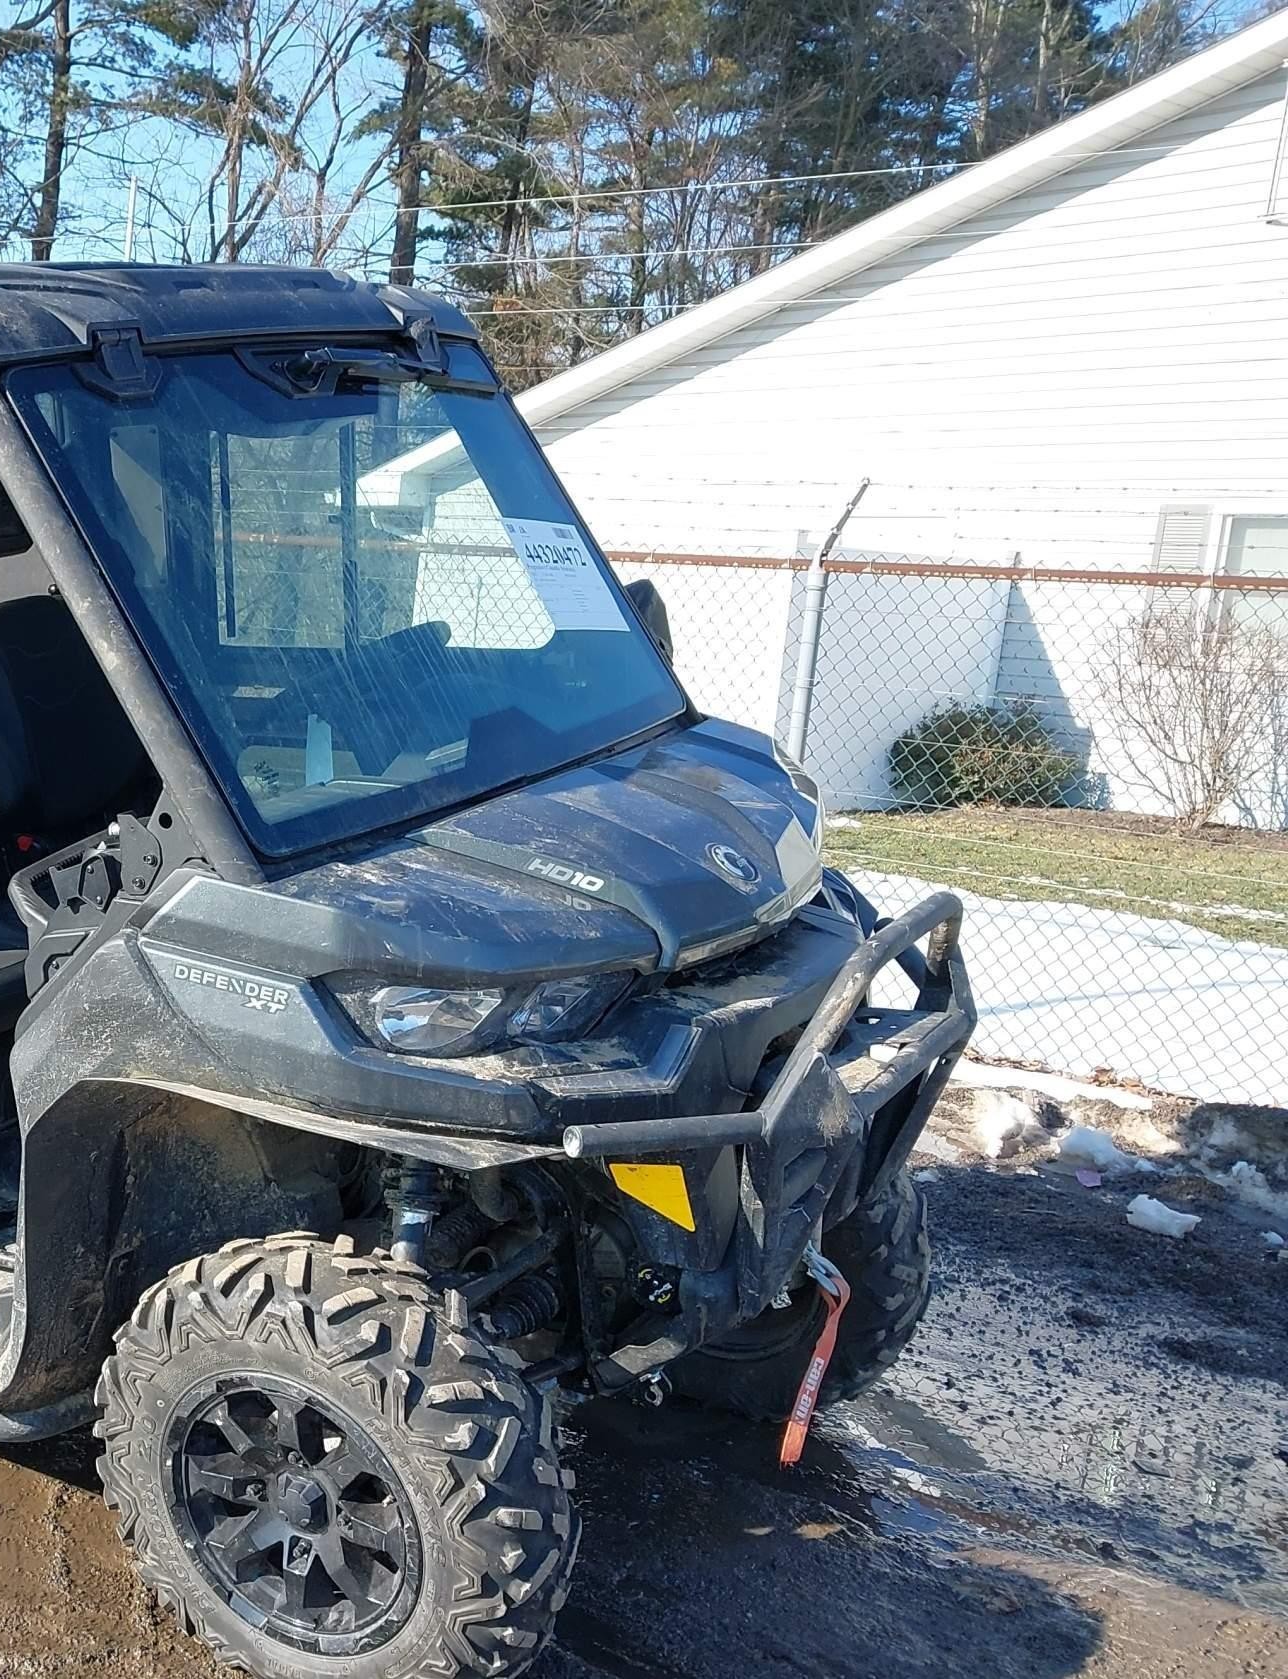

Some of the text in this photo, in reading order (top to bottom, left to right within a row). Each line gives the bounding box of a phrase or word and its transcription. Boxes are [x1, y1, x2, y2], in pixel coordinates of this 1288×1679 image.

[525, 543, 587, 566] 44320472
[527, 857, 605, 892] HD10
[175, 964, 289, 1004] DEFENDER
[243, 998, 287, 1014] XT
